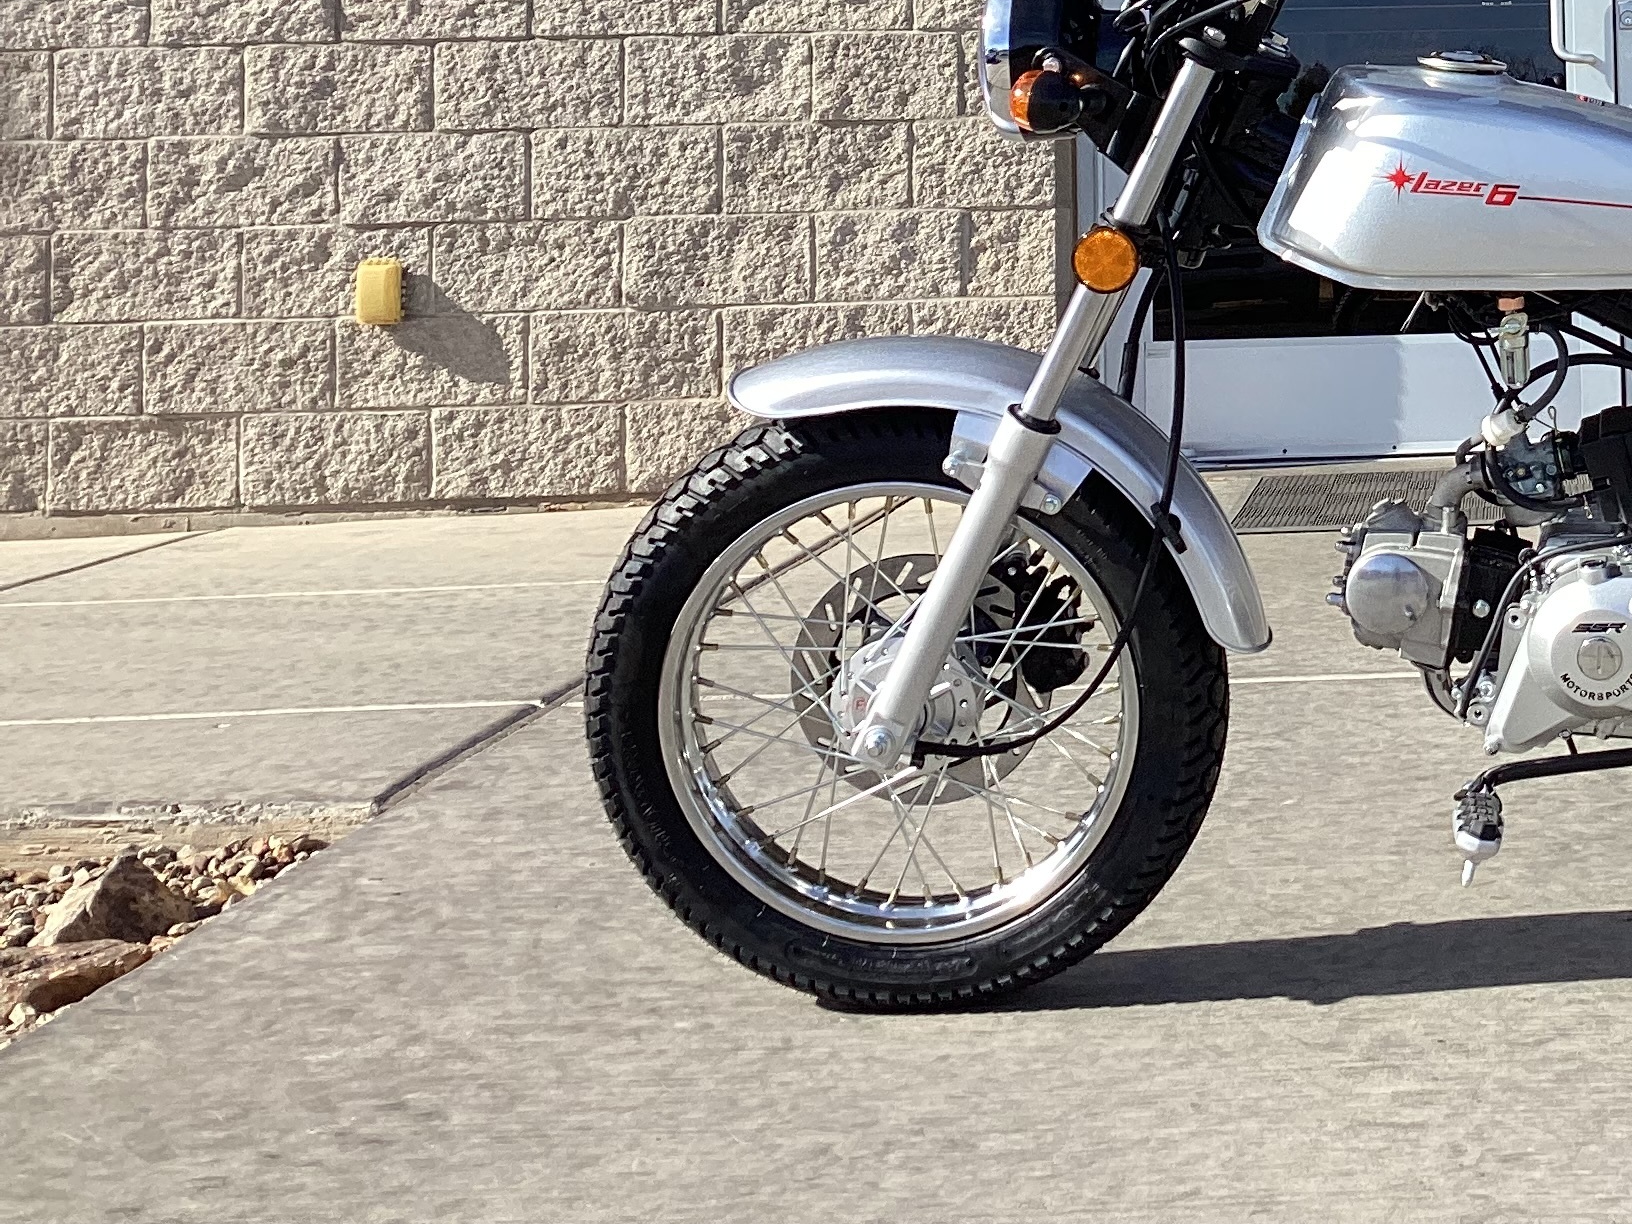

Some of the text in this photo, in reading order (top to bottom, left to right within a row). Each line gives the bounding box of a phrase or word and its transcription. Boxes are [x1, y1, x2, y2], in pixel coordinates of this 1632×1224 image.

[1410, 172, 1521, 207] Lazer 6
[1571, 622, 1628, 634] SSR
